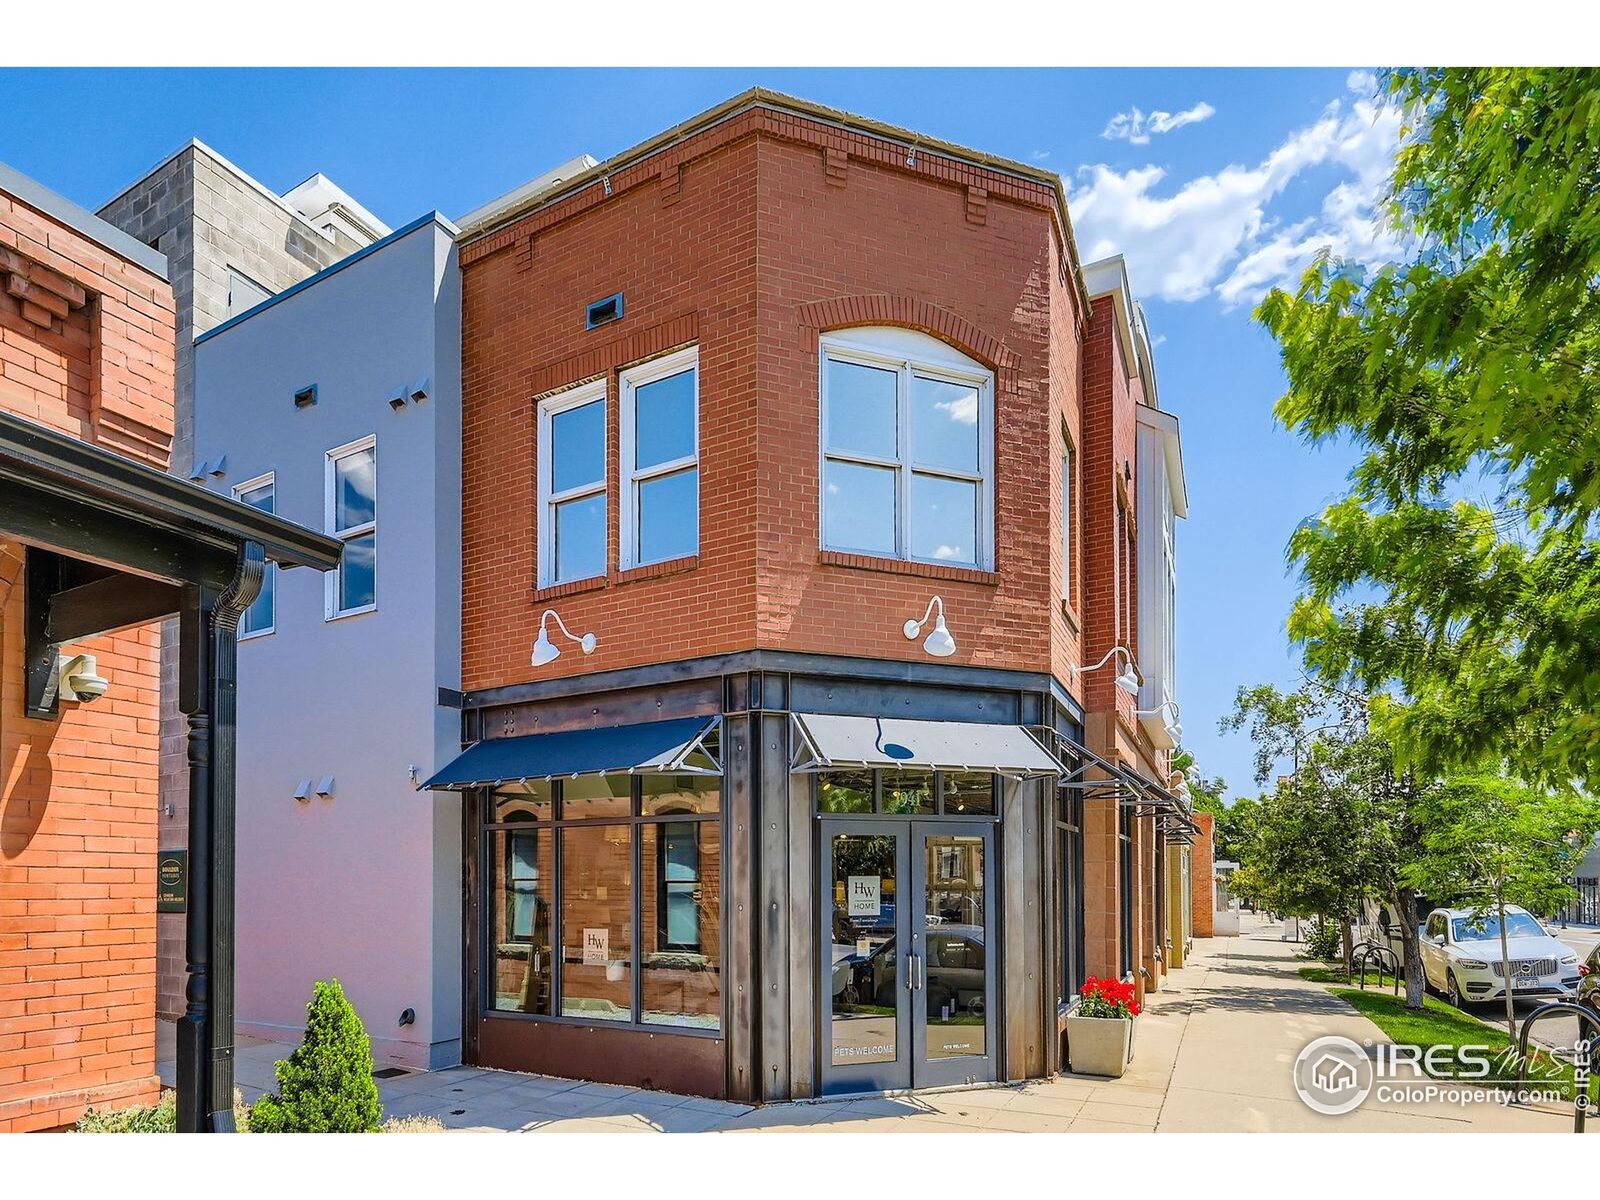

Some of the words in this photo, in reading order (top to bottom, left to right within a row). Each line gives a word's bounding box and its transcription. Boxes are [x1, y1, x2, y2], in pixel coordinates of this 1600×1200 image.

[854, 902, 875, 910] HOME
[834, 1047, 854, 1056] PETS
[856, 1044, 894, 1055] WELCOME
